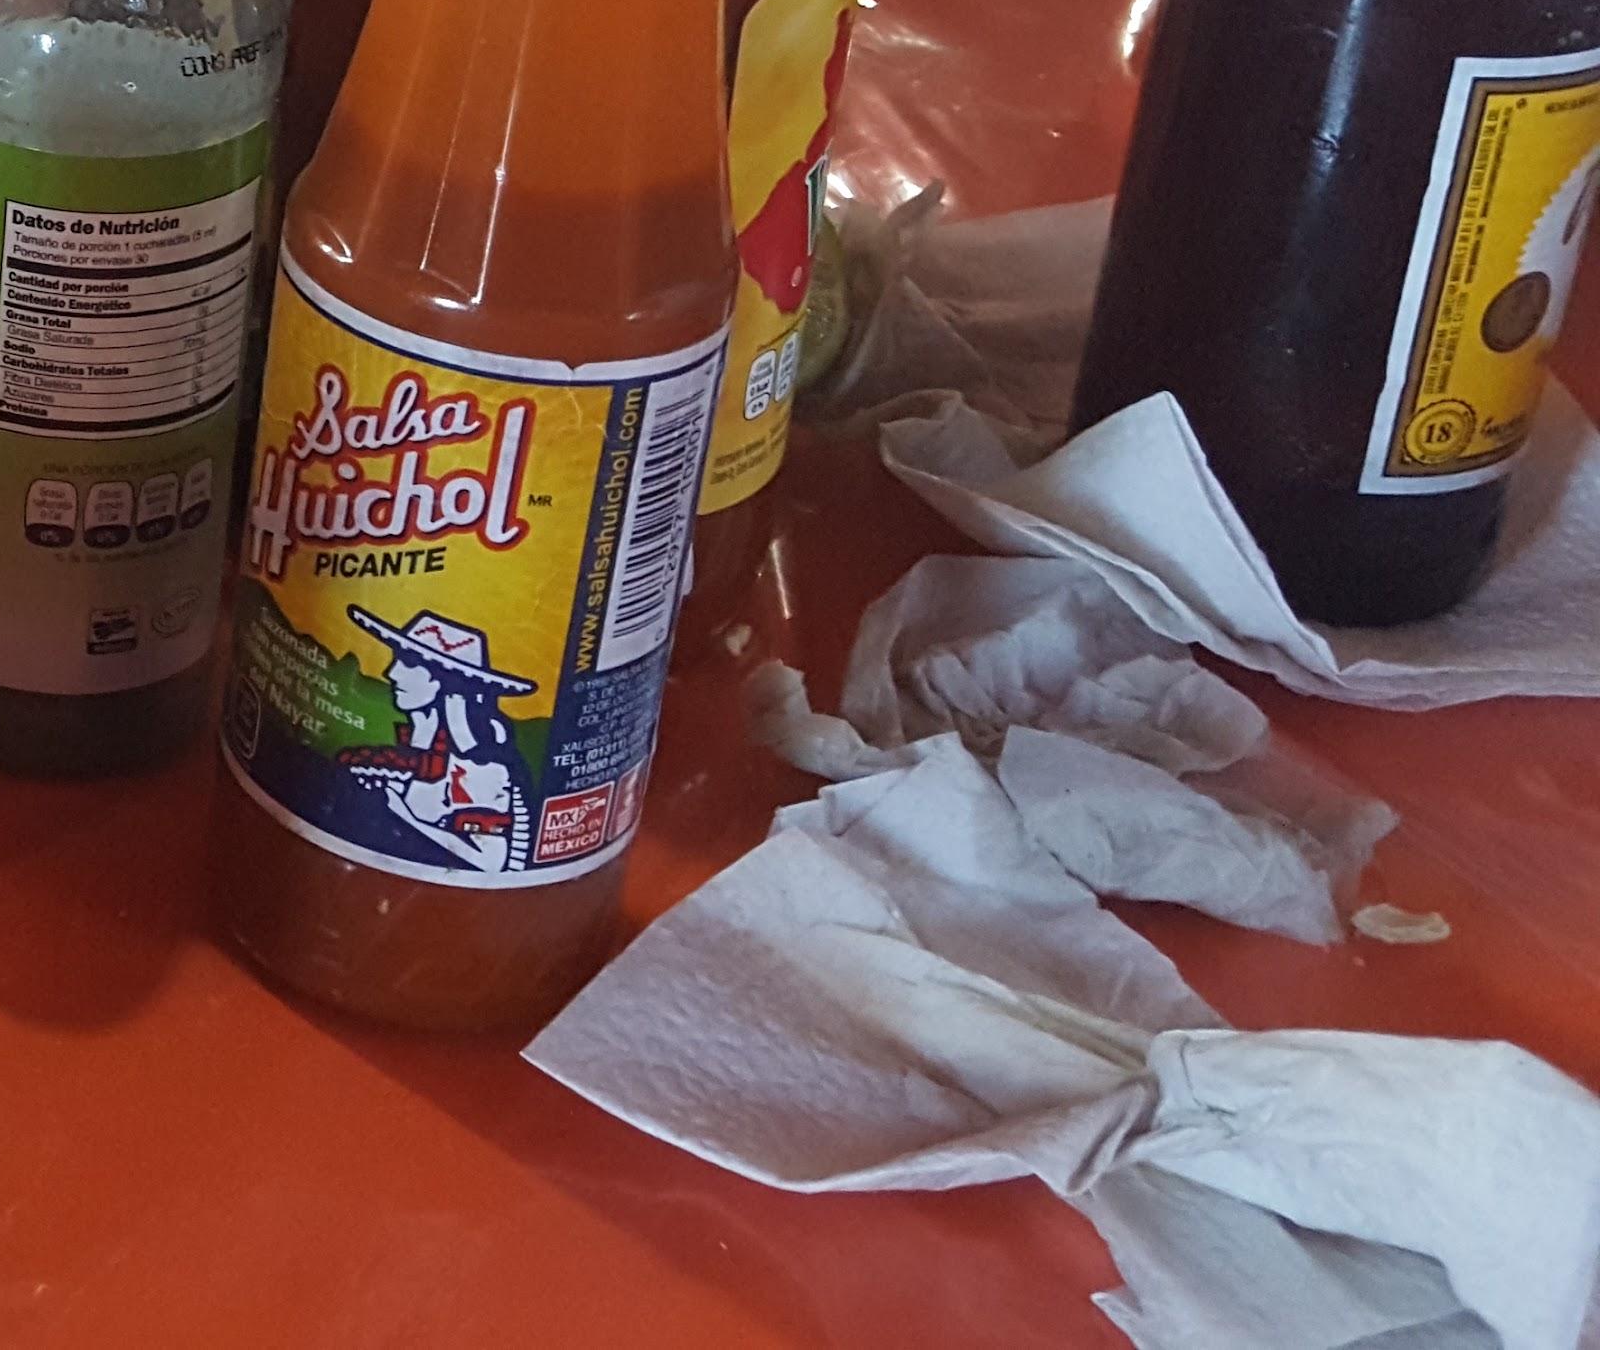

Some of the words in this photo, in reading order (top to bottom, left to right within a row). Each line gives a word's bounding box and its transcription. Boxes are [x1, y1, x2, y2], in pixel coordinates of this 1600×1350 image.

[12, 210, 65, 233] Datos
[70, 219, 94, 235] de
[99, 216, 180, 235] Nutrición
[14, 231, 58, 249] Tamaño
[61, 237, 76, 250] de
[13, 245, 67, 263] Porciones
[70, 254, 89, 267] por
[92, 255, 133, 266] envase
[8, 271, 60, 291] Cantidad
[62, 282, 82, 295] por
[7, 289, 65, 309] Contenido
[6, 309, 39, 327] Grasa
[42, 315, 71, 329] Total
[7, 325, 41, 340] Grasa
[3, 340, 36, 355] Sodio
[289, 370, 483, 460] Salsa
[1425, 421, 1453, 443] 18
[250, 406, 527, 576] Huichol
[528, 494, 553, 507] MR
[575, 387, 644, 674] www.salsahuichol.com
[314, 546, 447, 578] PICANTE
[314, 695, 366, 730] mesa
[553, 753, 584, 767] TEL:
[550, 812, 575, 827] MX
[544, 823, 585, 840] HECHO
[540, 831, 600, 856] MEXICO
